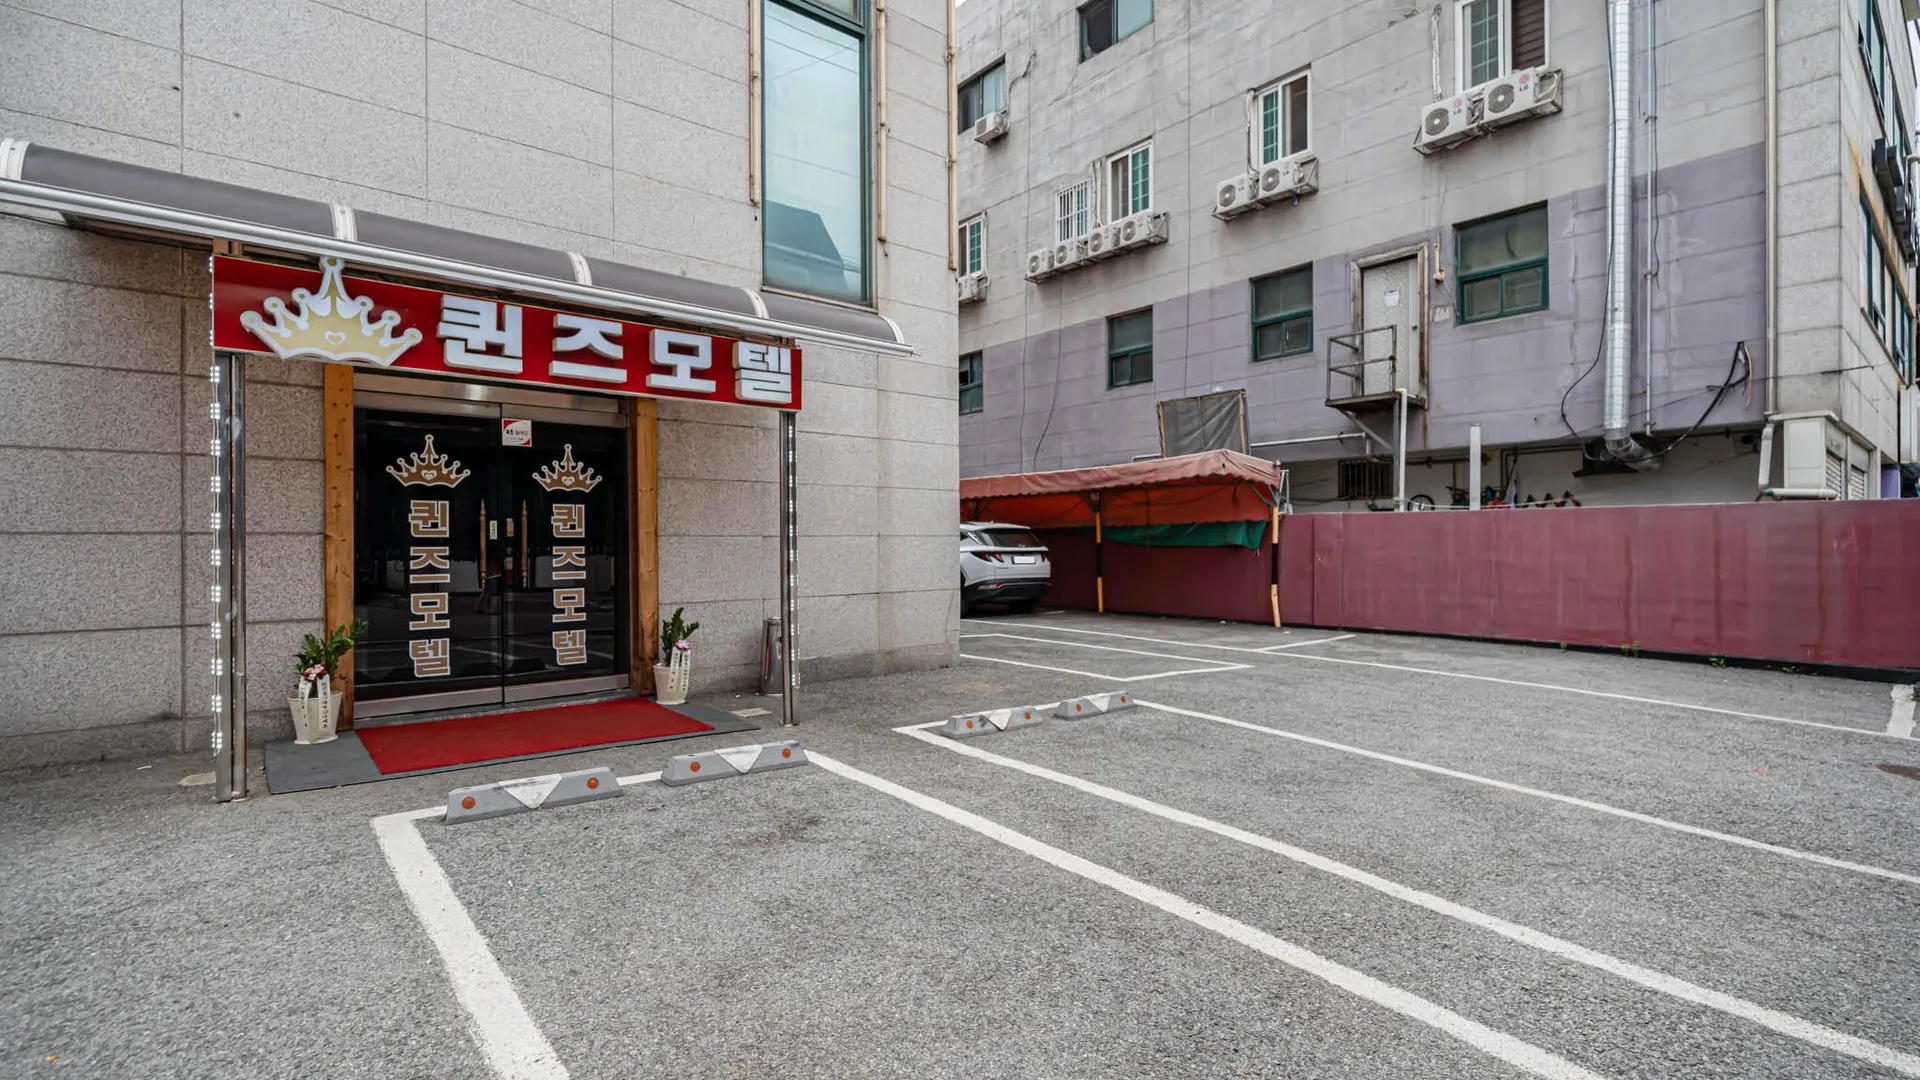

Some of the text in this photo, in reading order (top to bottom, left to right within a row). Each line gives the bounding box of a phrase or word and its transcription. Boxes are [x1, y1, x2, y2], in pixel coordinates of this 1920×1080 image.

[437, 294, 792, 403] 퀸즈모텔
[408, 500, 451, 677] 퀸즈모텔
[551, 503, 588, 666] 퀸즈모텔
